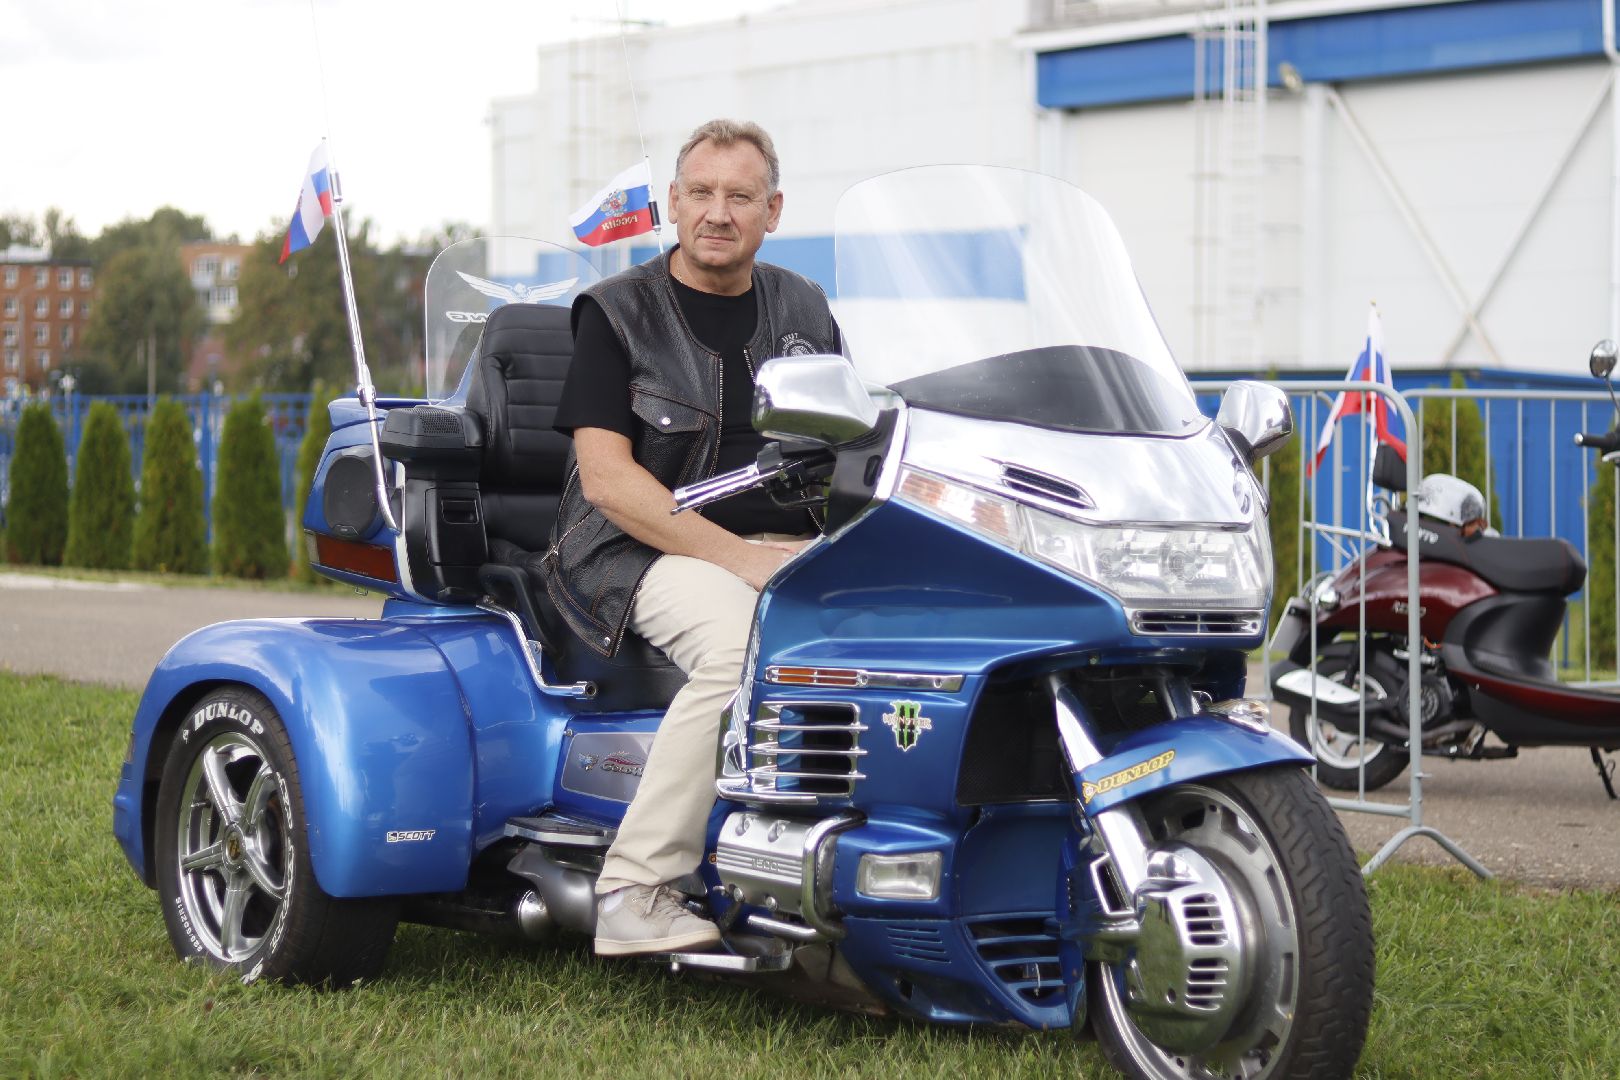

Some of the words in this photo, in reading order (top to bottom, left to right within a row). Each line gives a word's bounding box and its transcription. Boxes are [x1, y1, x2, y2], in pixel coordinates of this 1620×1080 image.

[194, 702, 264, 735] DUNLOP
[1099, 751, 1174, 792] DUNLOP
[398, 830, 435, 841] SCOTT
